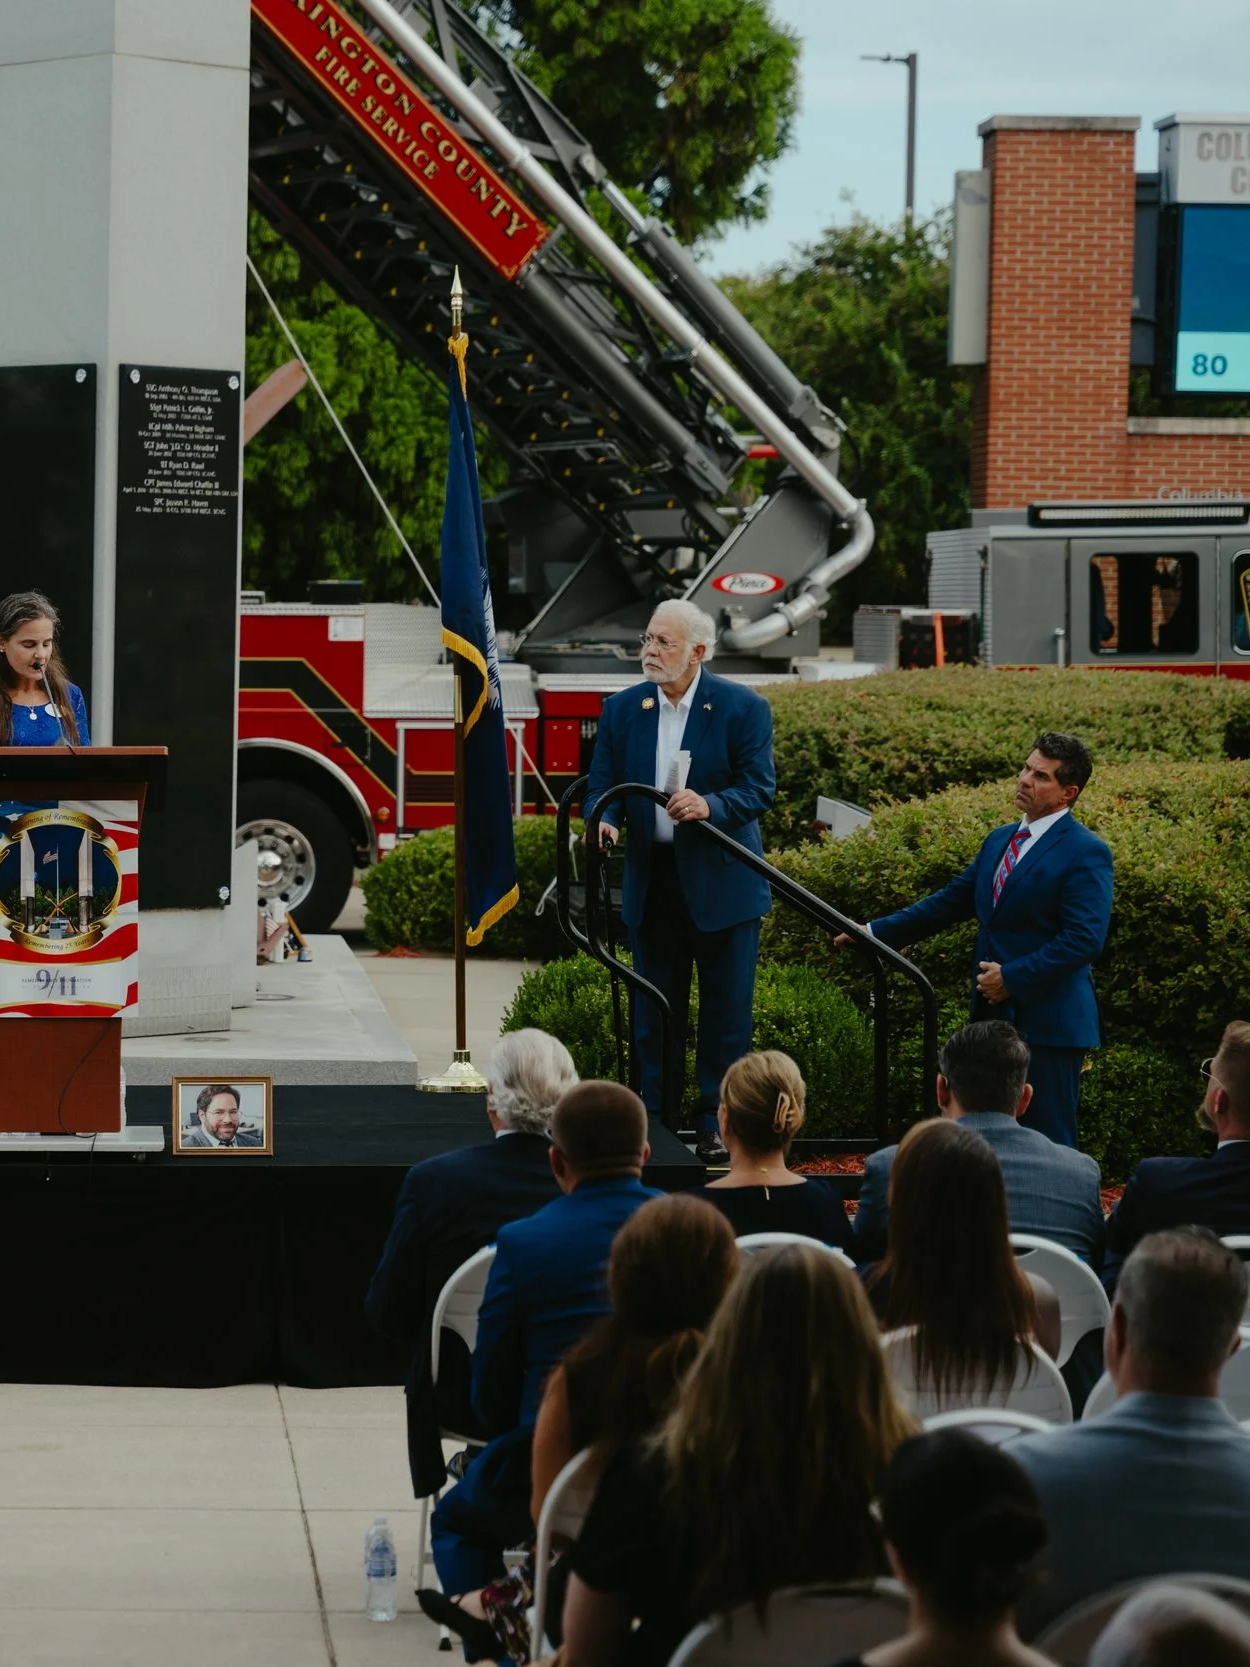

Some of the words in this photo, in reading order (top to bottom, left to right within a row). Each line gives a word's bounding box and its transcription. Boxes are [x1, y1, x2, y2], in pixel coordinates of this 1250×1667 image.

[313, 45, 362, 97] FIRE
[360, 95, 440, 180] SERVICE
[1197, 131, 1250, 162] COL
[420, 120, 529, 239] COUNTY
[1192, 353, 1228, 377] 80
[190, 386, 219, 397] Thompson
[163, 403, 181, 413] Patrick
[175, 424, 193, 432] Palmer
[155, 441, 169, 451] John
[168, 461, 183, 470] Ryan
[156, 479, 173, 488] James
[173, 480, 194, 488] Edward
[153, 497, 164, 506] SPC
[191, 499, 209, 507] Haven
[45, 811, 53, 822] of
[53, 812, 94, 830] Remembra
[23, 938, 63, 951] Remembering
[73, 938, 90, 947] Years
[36, 967, 78, 999] 9/11
